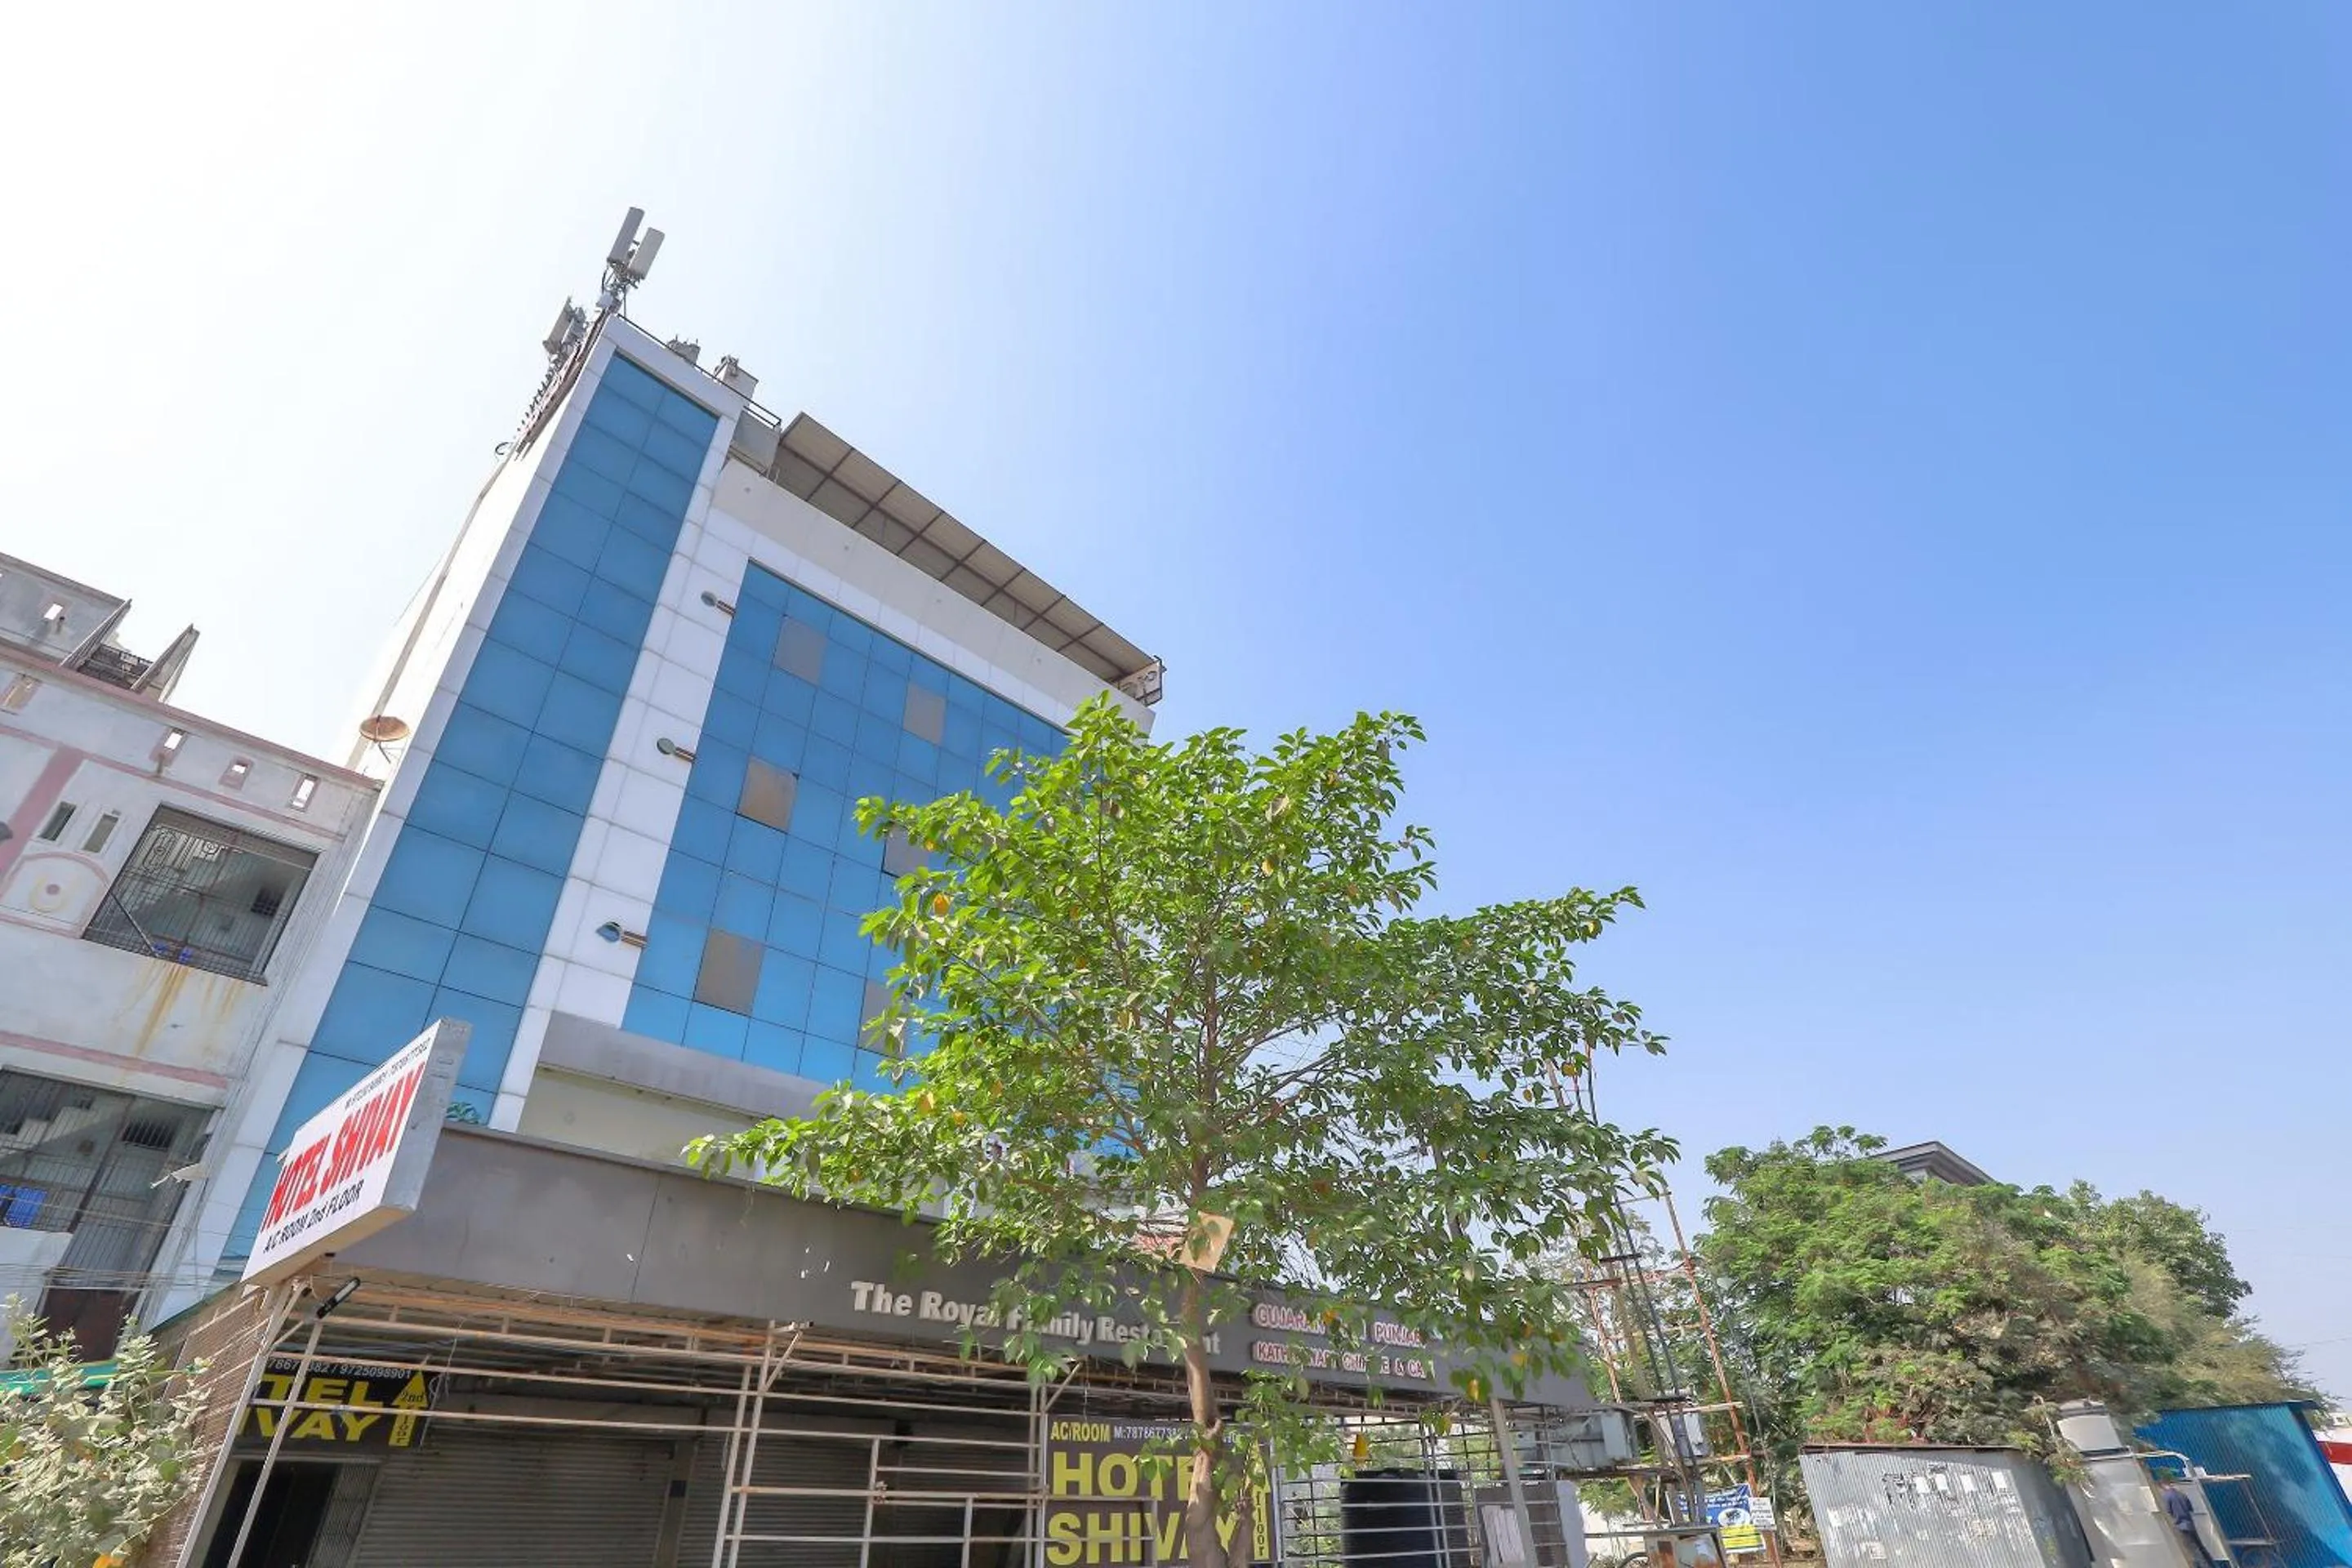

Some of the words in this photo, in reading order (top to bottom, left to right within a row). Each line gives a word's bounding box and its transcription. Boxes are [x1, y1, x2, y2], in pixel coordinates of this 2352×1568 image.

[260, 1133, 331, 1234] HOTEL
[318, 1060, 425, 1196] SHIVAY
[326, 1179, 365, 1218] FLOOR
[851, 1281, 913, 1316] The
[1006, 1305, 1094, 1346] Fmily
[1053, 1451, 1197, 1501] HOTE
